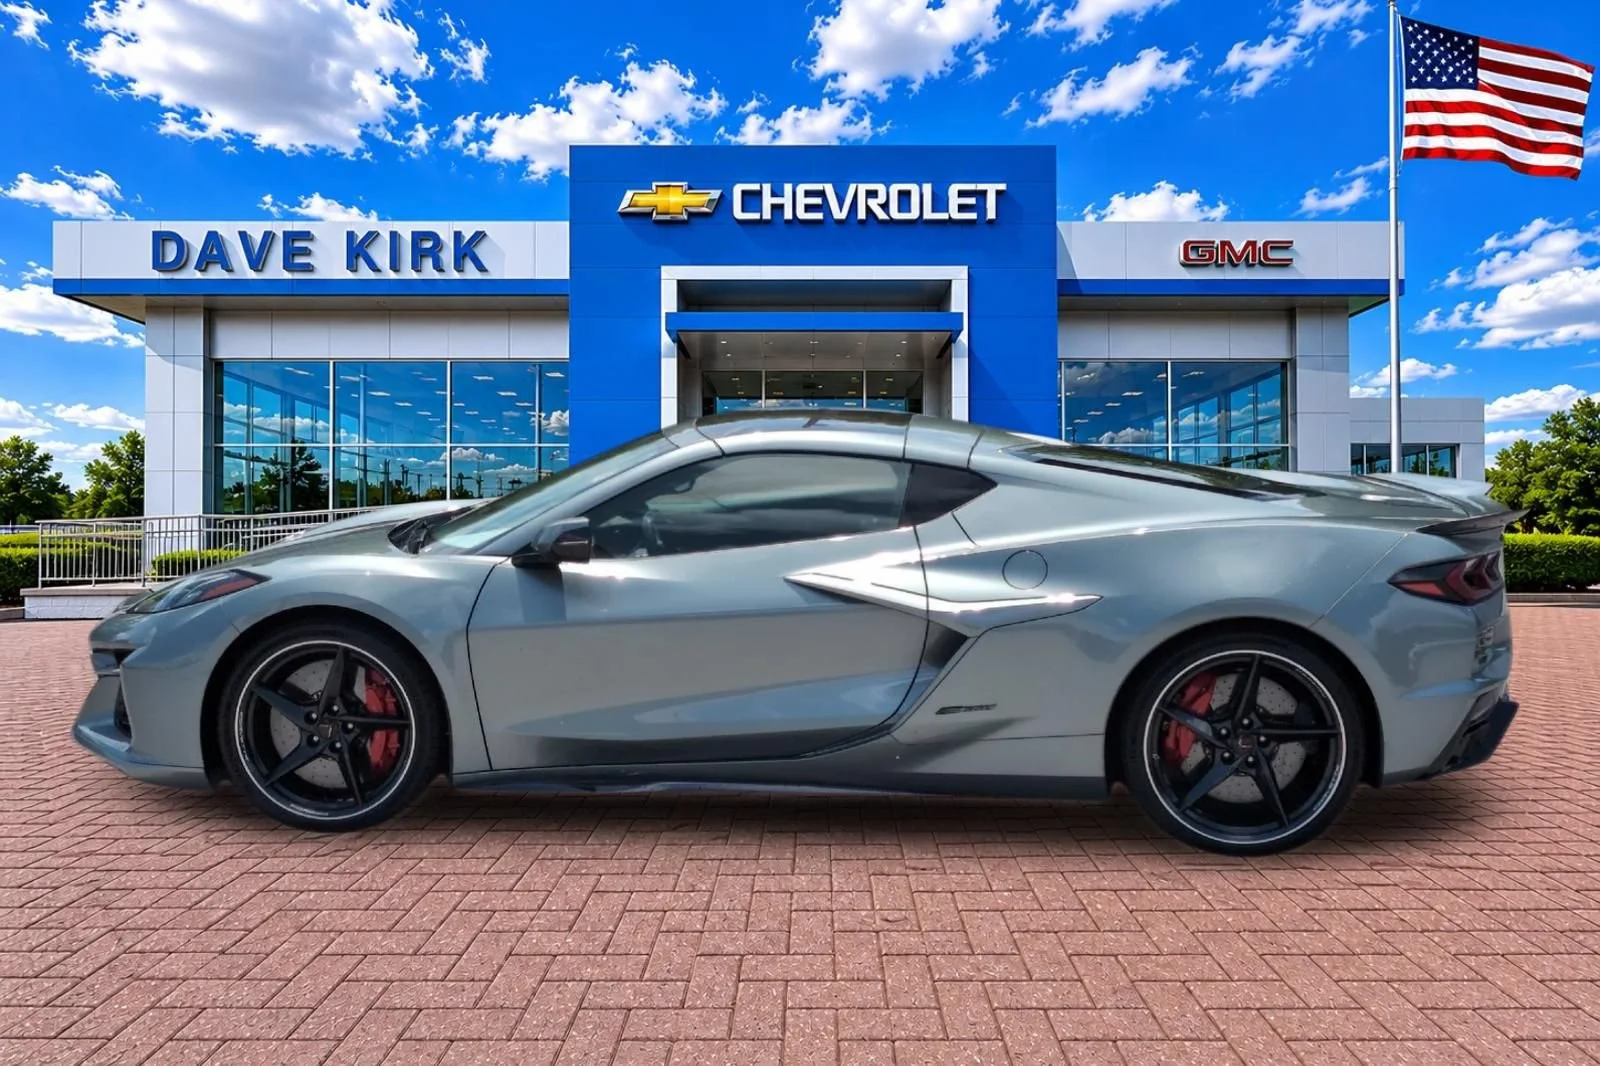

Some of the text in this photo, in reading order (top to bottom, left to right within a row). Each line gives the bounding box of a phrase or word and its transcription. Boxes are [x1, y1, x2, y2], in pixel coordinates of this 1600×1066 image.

[732, 183, 1007, 222] CHEVROLET
[151, 230, 489, 273] DAVE KIRK
[1179, 239, 1295, 267] GMC
